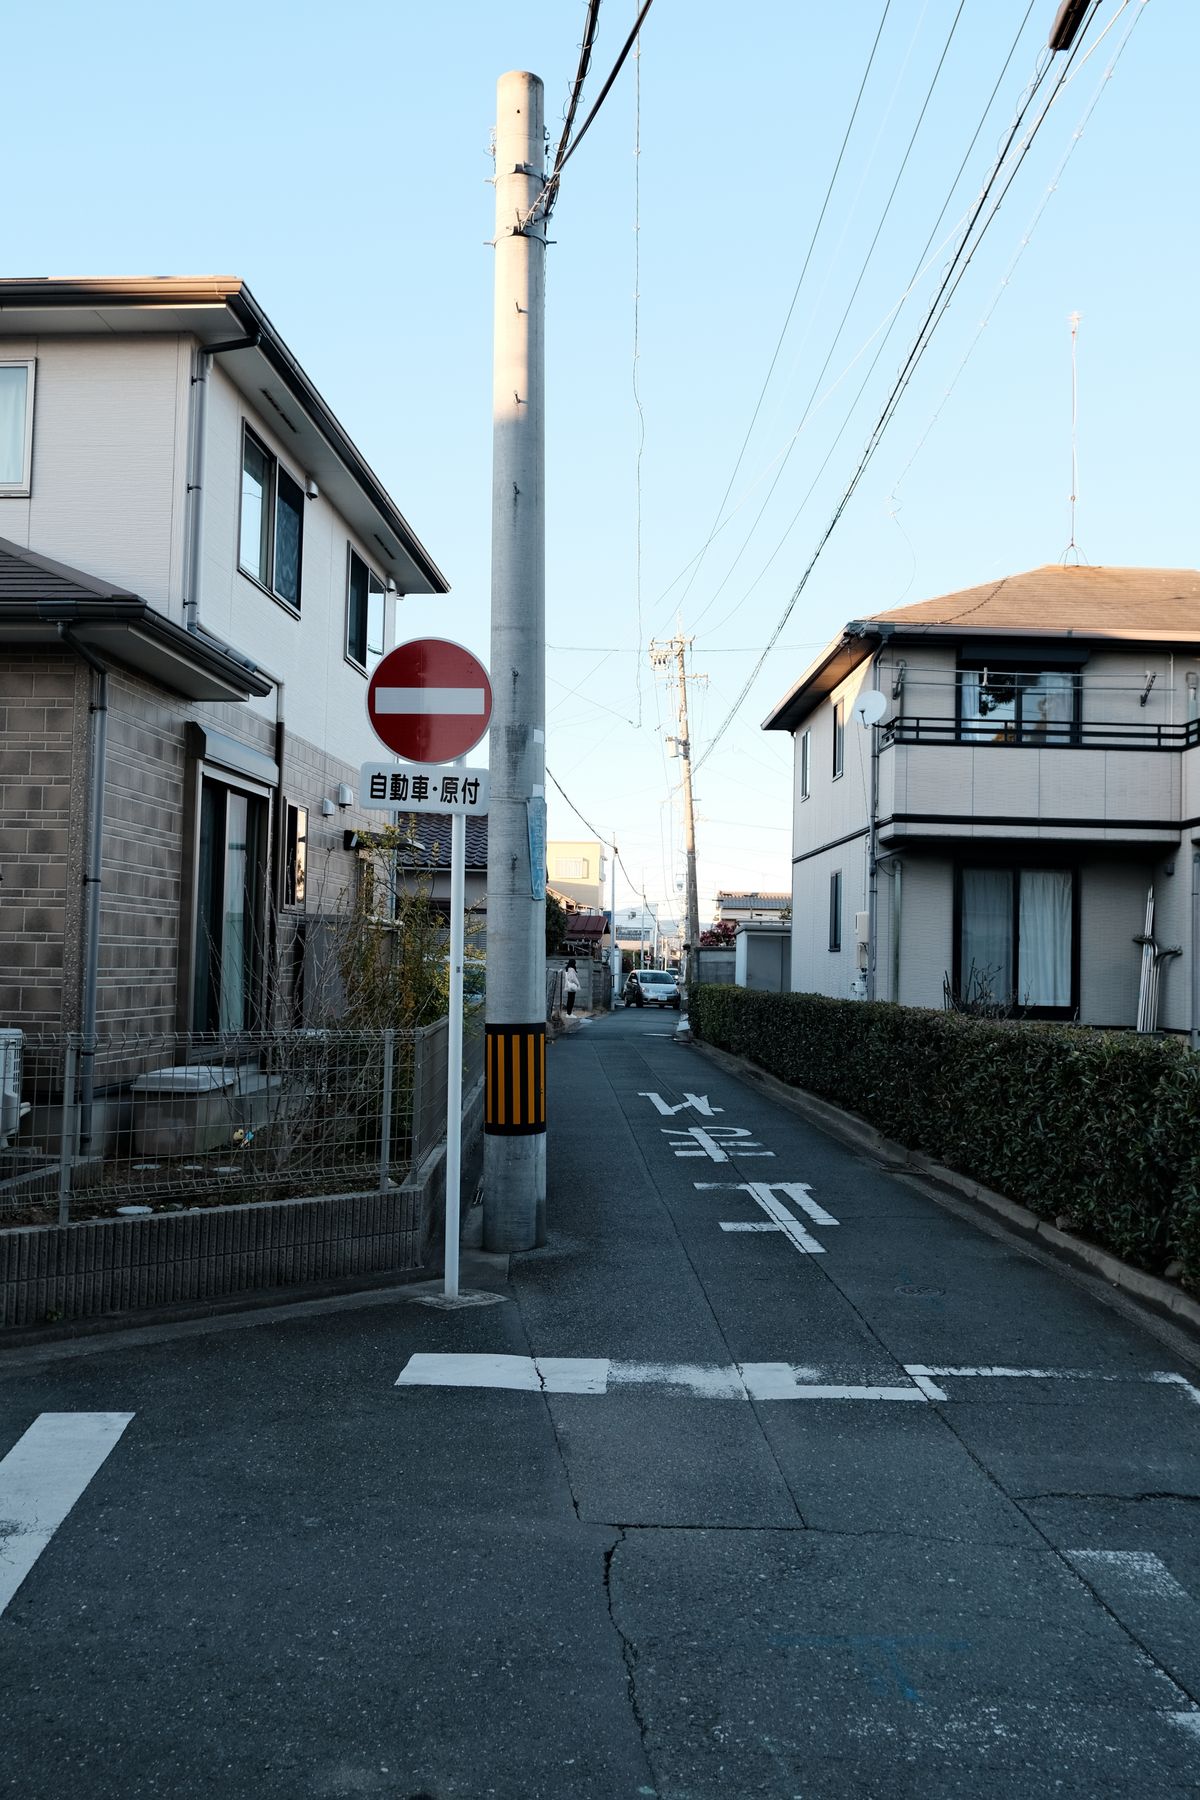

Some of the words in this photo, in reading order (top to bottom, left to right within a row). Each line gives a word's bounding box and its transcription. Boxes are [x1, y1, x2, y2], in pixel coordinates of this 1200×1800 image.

[369, 772, 481, 805] 自動車・原付
[637, 1092, 841, 1254] 止まれ
